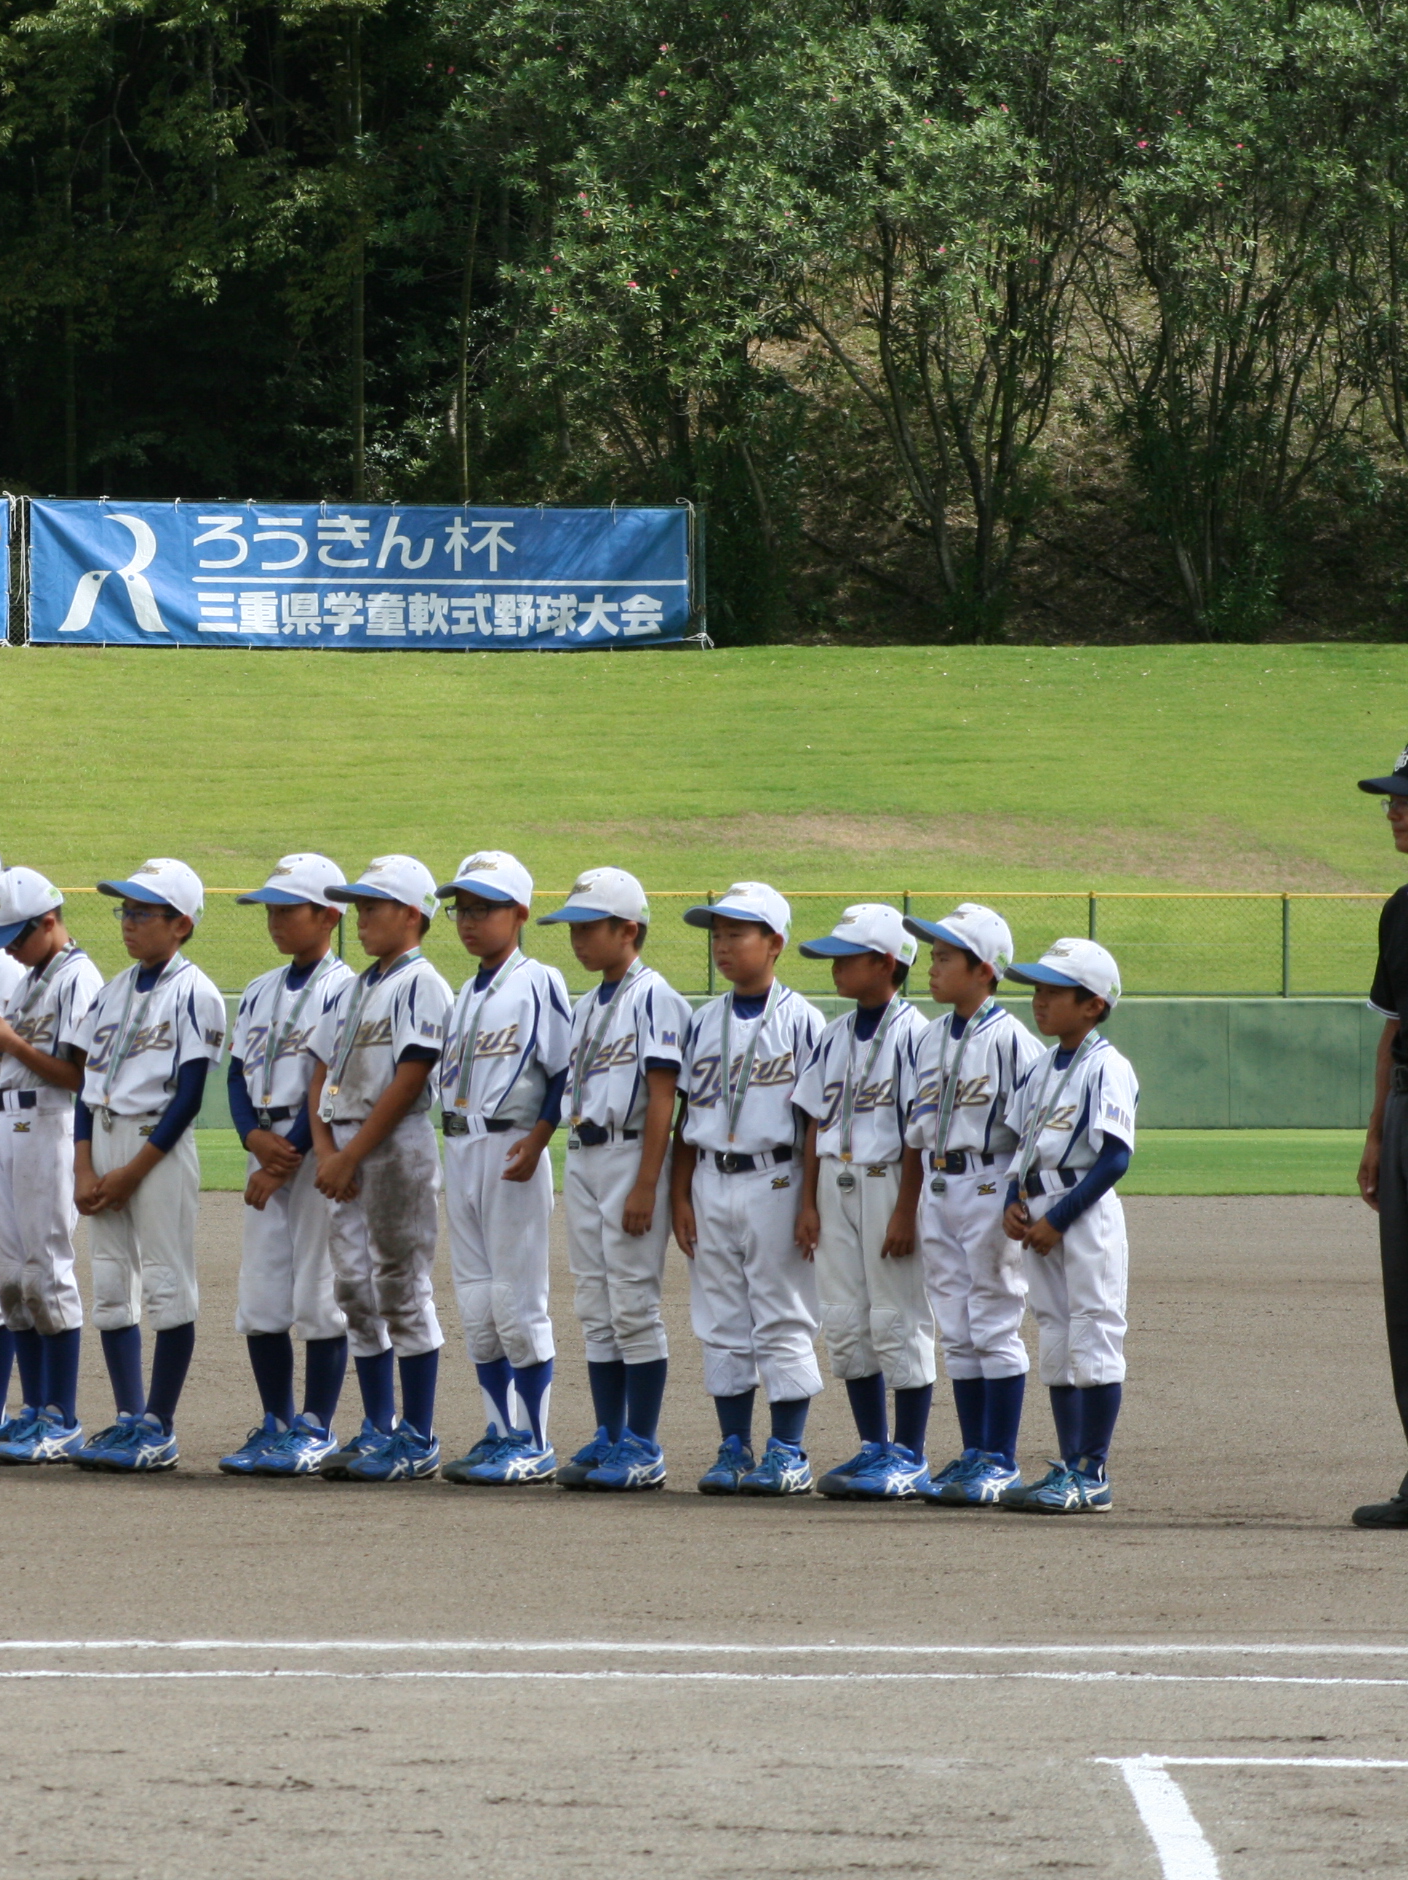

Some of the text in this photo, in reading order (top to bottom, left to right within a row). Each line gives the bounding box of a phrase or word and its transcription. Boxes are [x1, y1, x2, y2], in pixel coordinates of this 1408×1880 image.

[192, 514, 516, 573] ろうきん杯
[196, 591, 664, 636] 三重県学童軟式野球大会
